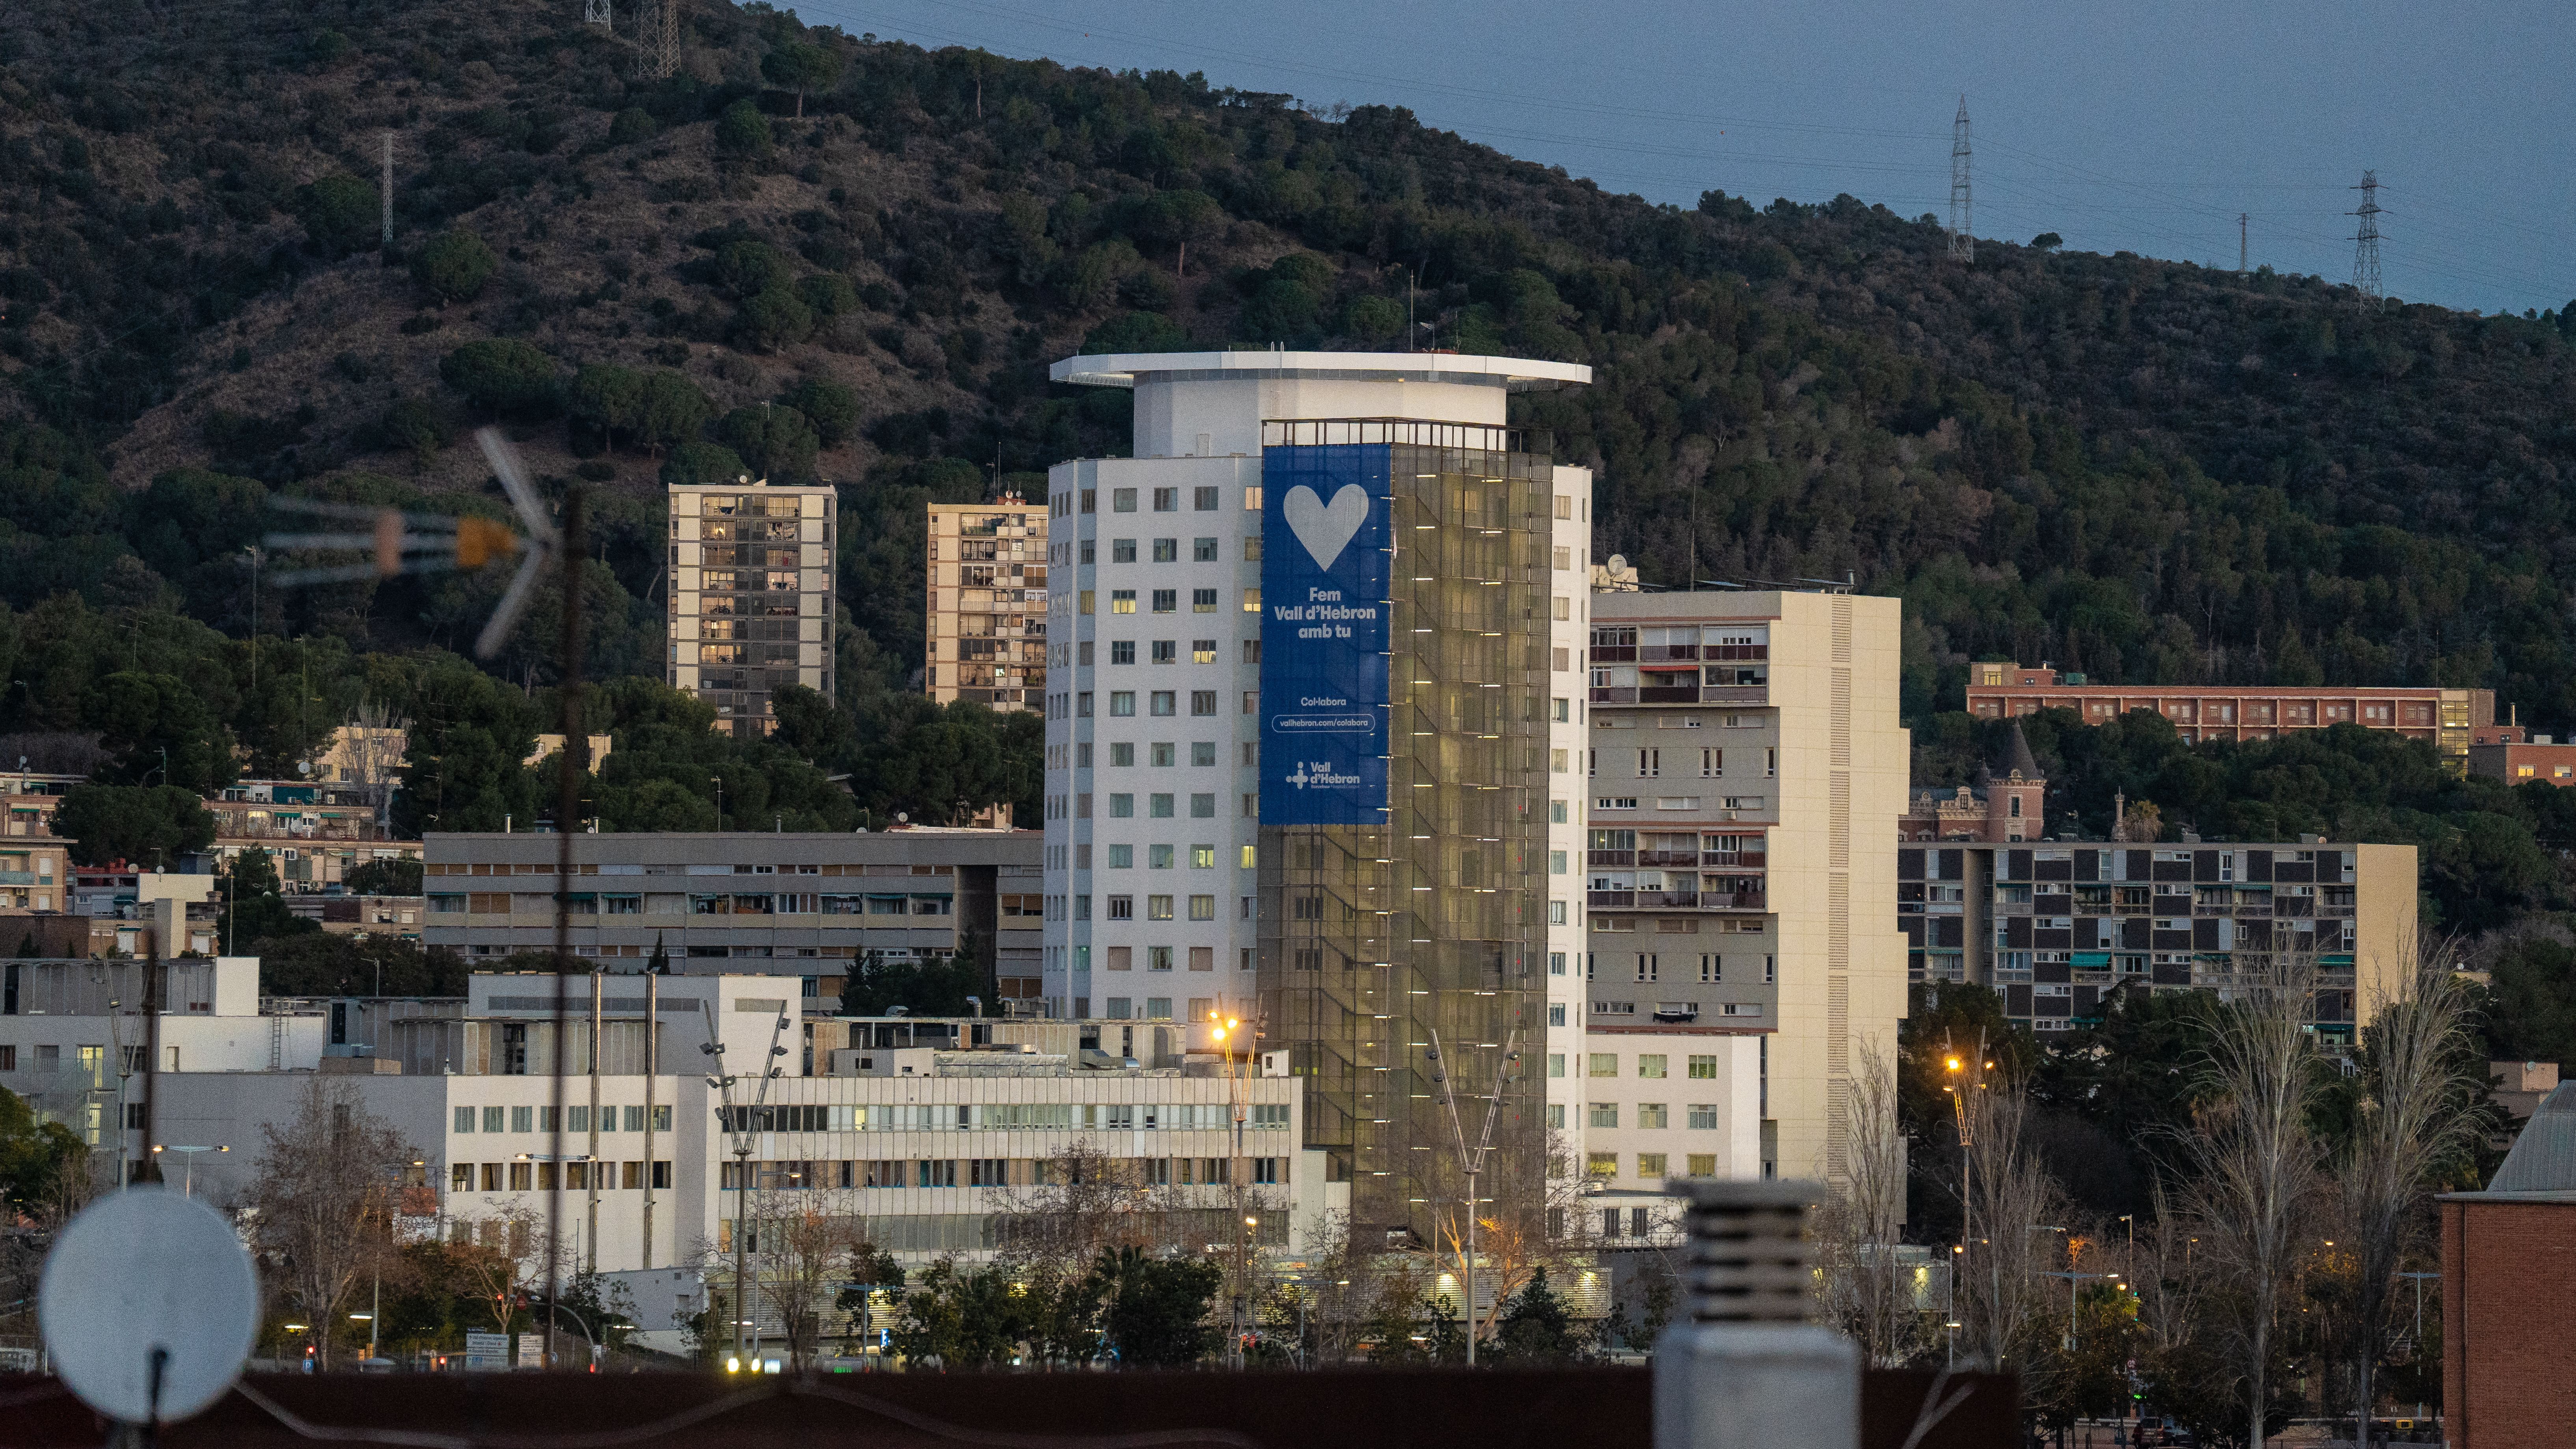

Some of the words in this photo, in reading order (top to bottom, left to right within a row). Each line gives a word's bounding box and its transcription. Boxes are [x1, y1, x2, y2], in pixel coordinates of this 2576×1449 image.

[1309, 587, 1341, 601] Fem
[1274, 606, 1302, 620] Vall
[1306, 605, 1376, 620] d'Hebron
[1298, 623, 1332, 638] amb
[1335, 625, 1351, 638] tu
[1301, 697, 1346, 706] Col·labora
[1311, 762, 1330, 772] Vall
[1310, 773, 1360, 784] d'Hebron
